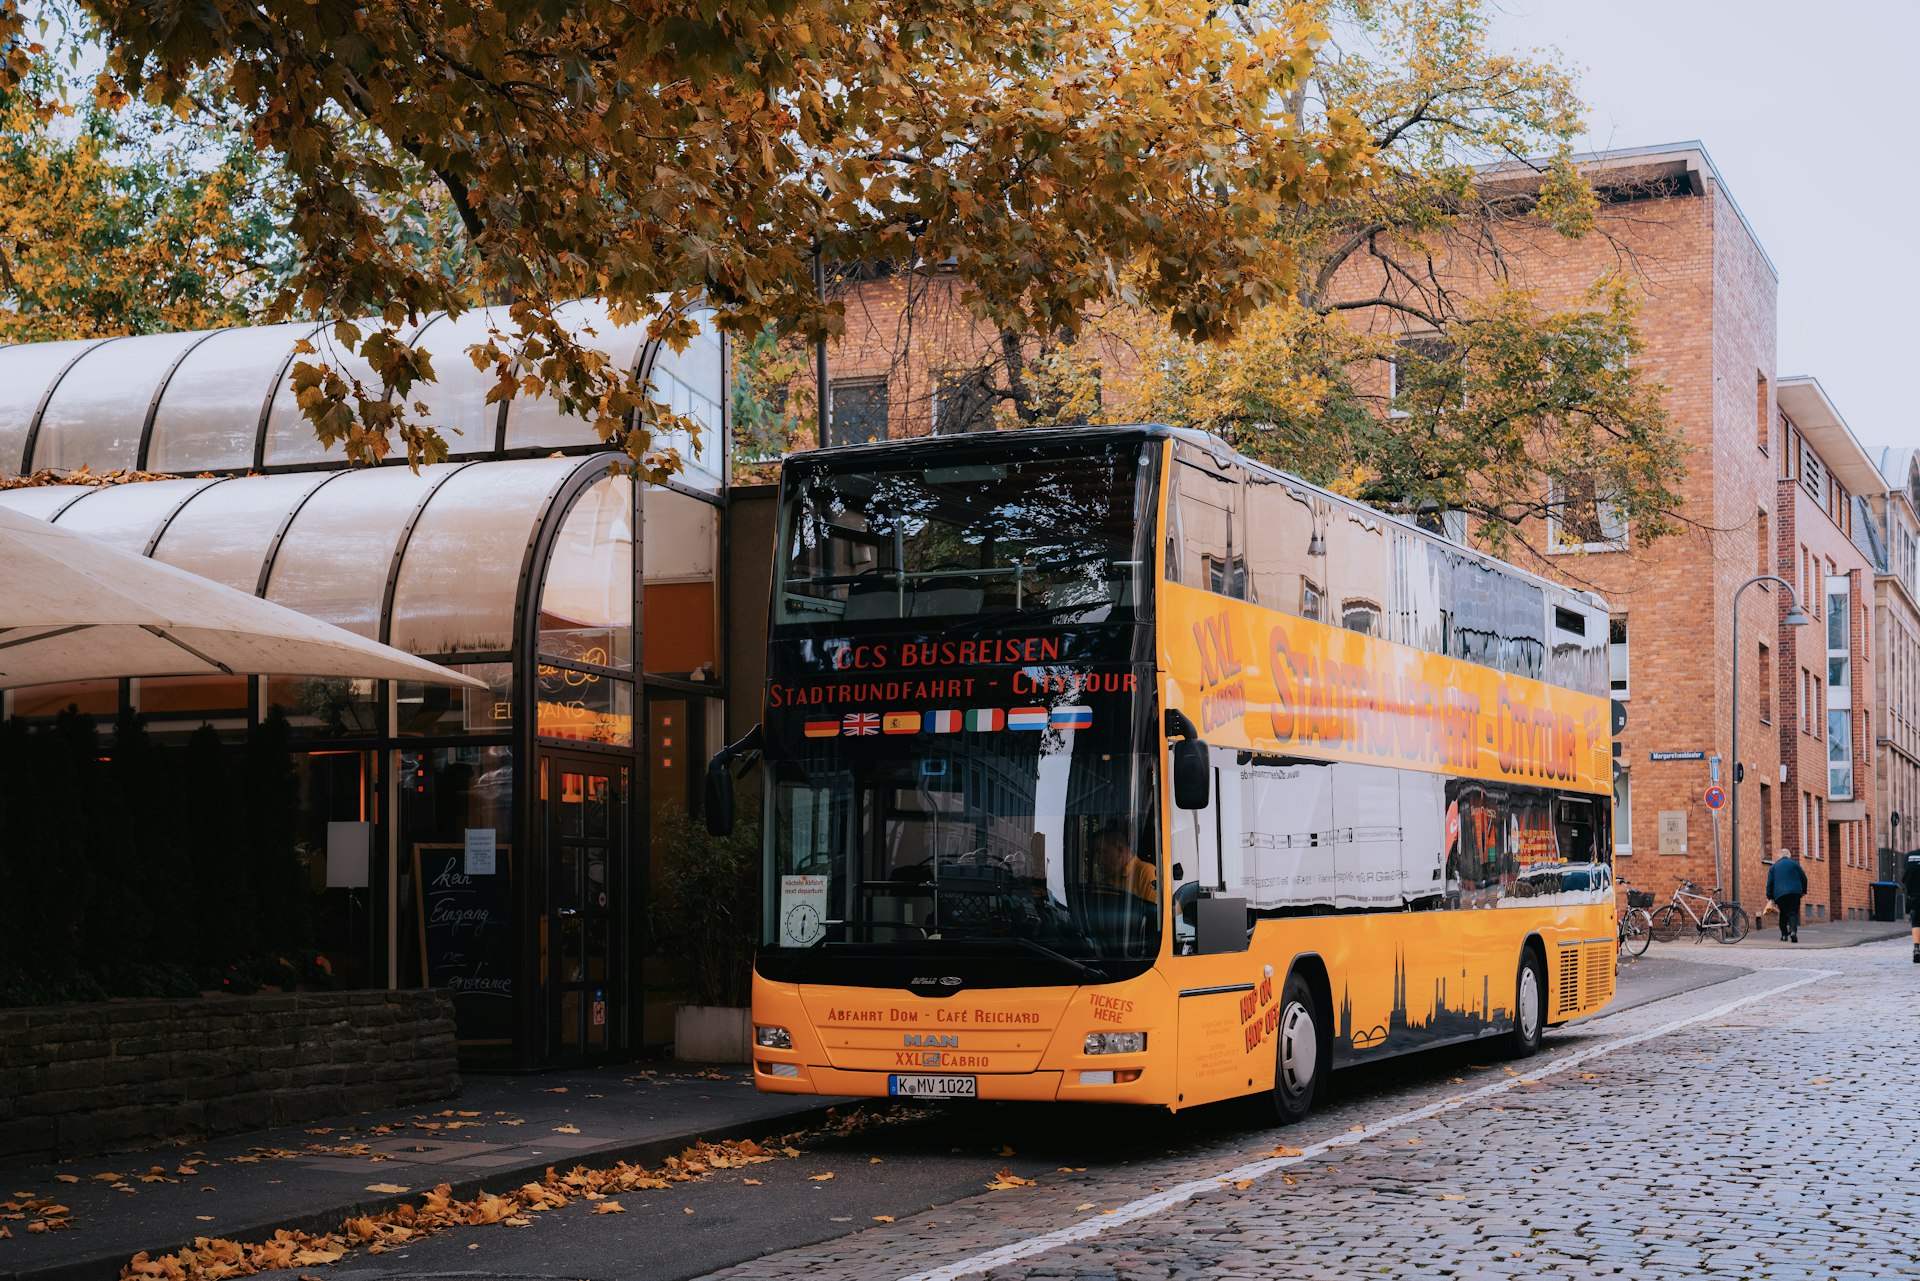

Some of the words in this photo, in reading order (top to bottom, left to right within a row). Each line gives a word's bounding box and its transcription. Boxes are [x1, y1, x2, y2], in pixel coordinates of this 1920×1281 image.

[837, 645, 888, 670] CCS
[901, 637, 1059, 667] BUSREISEN
[1192, 609, 1242, 692] XXL
[769, 678, 976, 708] STADTRUNDFAHRT
[1013, 670, 1138, 695] CITYTOUR
[1202, 678, 1246, 734] CABRIO
[1497, 681, 1577, 782] CITYTOUR
[828, 1008, 884, 1022] ABFAHRT
[890, 1009, 918, 1022] DOM
[936, 1009, 968, 1023] CAFÉ
[975, 1010, 1040, 1023] REICHARD
[1090, 993, 1134, 1012] TICKETS
[1094, 1007, 1124, 1024] HERE
[1240, 988, 1258, 1025] HOP
[1260, 977, 1272, 1007] ON
[904, 1034, 958, 1048] MAN
[1245, 1017, 1263, 1054] HOP
[896, 1052, 922, 1066] XXL
[941, 1053, 989, 1067] CABRIO
[938, 1079, 974, 1094] 1022
